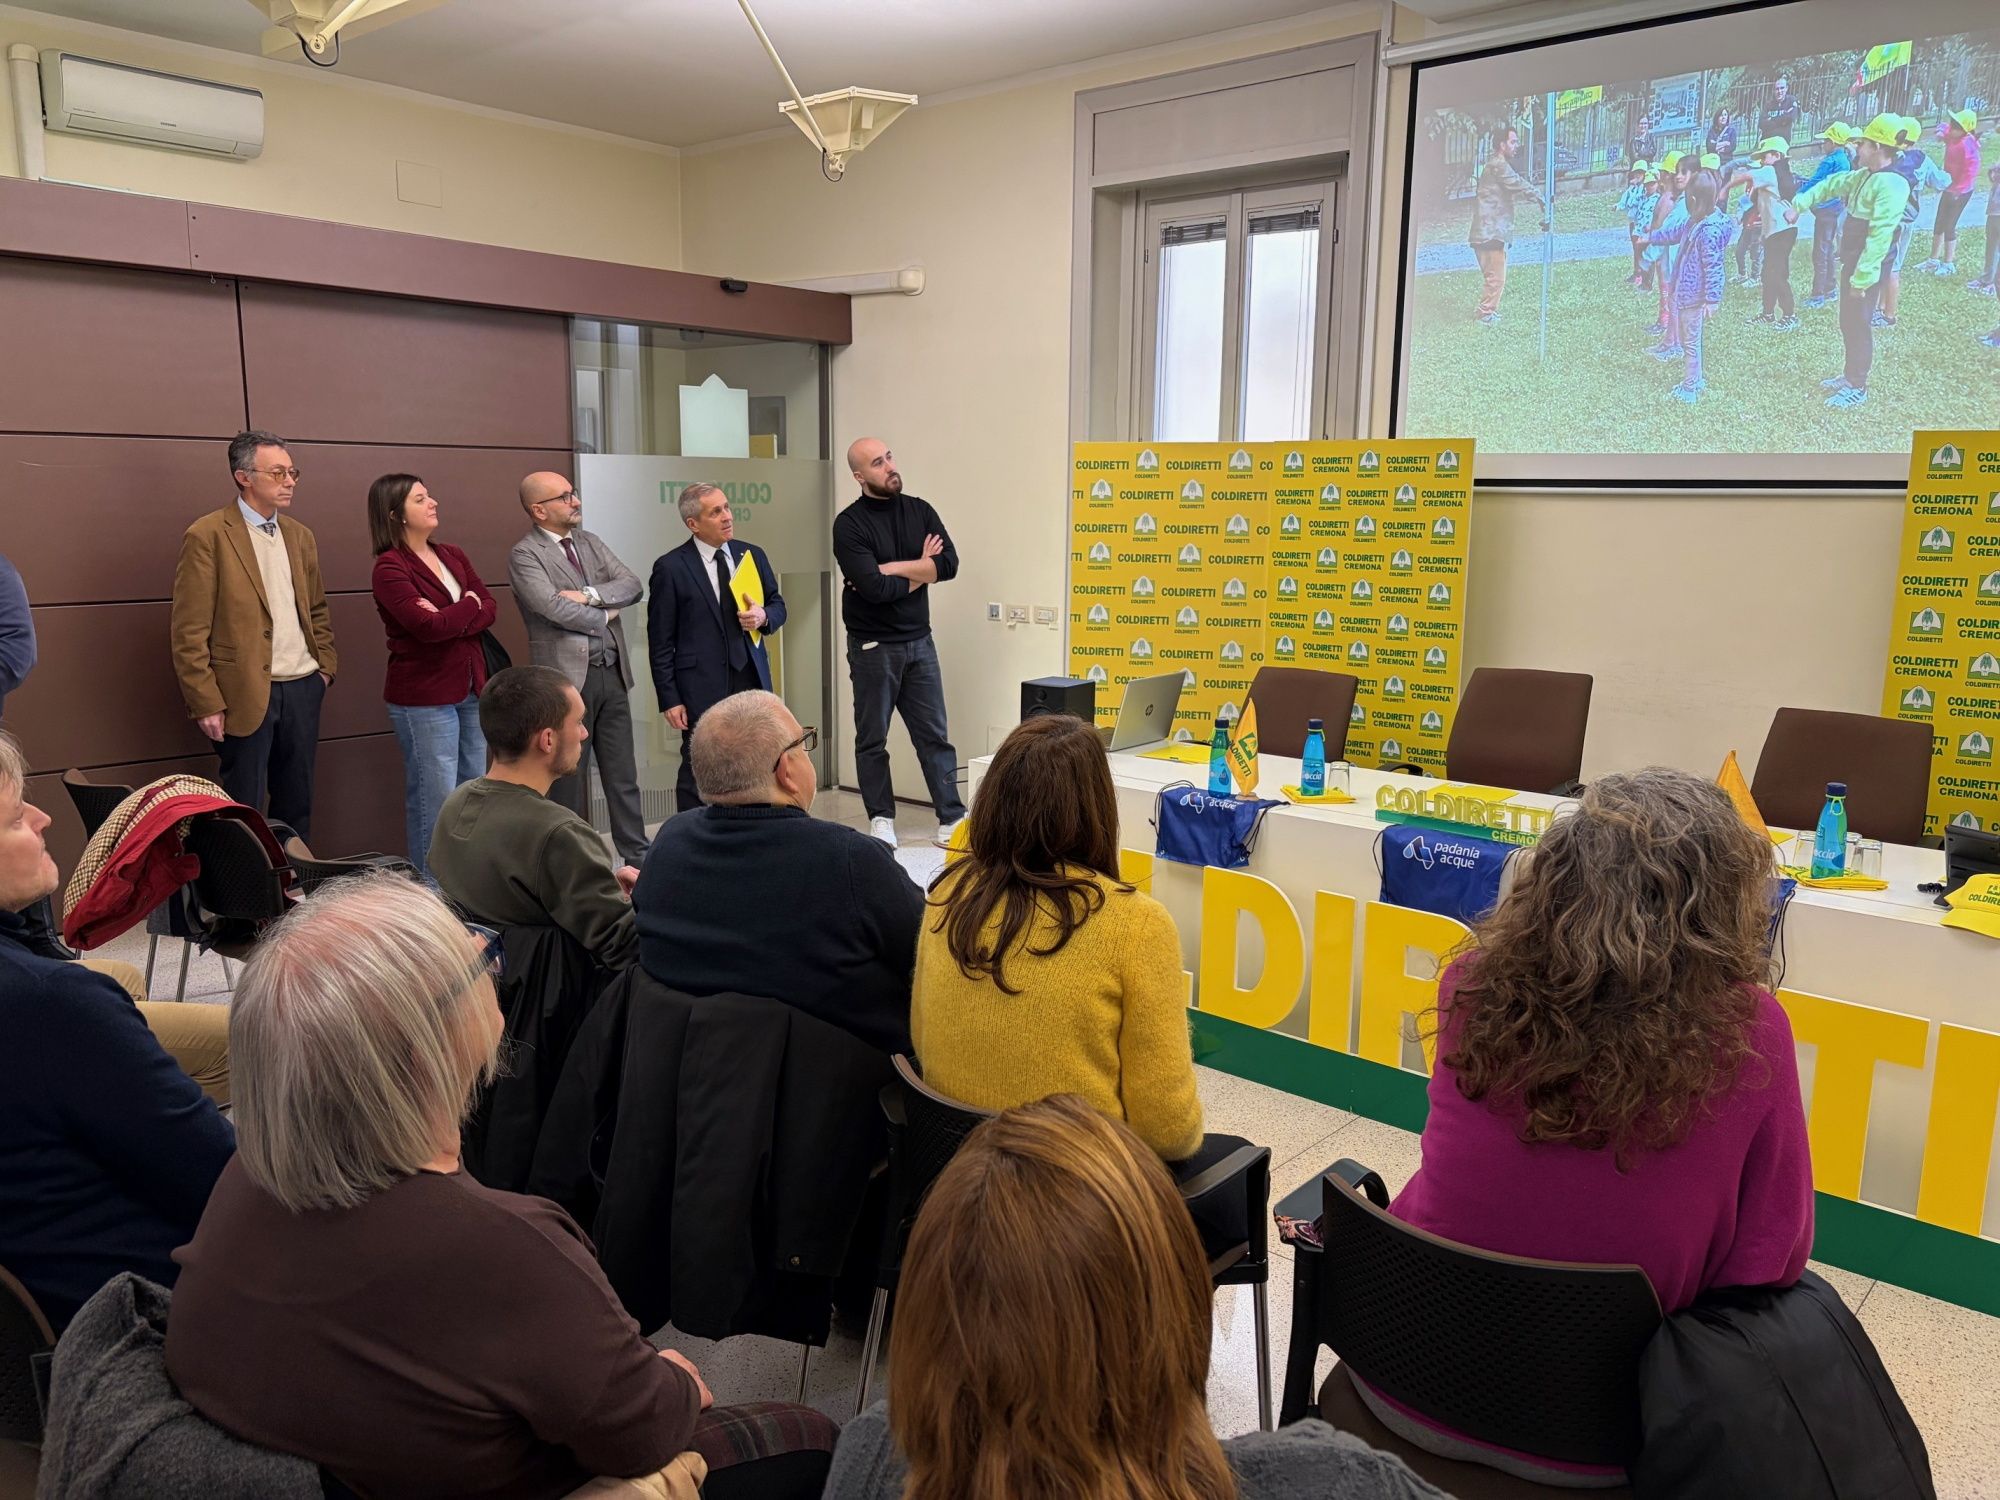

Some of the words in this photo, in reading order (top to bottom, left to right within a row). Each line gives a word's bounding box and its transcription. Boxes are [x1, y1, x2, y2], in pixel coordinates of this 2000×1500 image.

[1076, 461, 1129, 470] COLDIRETTI
[1166, 461, 1221, 470] COLDIRETTI
[1120, 491, 1173, 500] COLDIRETTI
[1211, 492, 1267, 501] COLDIRETTI
[1346, 490, 1388, 498] COLDIRETTI
[1912, 495, 1978, 504] COLDIRETTI
[1914, 507, 1973, 515] CREMONA
[1075, 524, 1127, 533] COLDIRETTI
[1164, 525, 1218, 534] COLDIRETTI
[1383, 522, 1425, 530] COLDIRETTI
[1118, 554, 1171, 563] COLDIRETTI
[1209, 555, 1264, 565] COLDIRETTI
[1343, 554, 1384, 562] COLDIRETTI
[1418, 556, 1462, 565] COLDIRETTI
[1419, 566, 1458, 574] CREMONA
[1903, 576, 1968, 587] COLDIRETTI
[1073, 586, 1125, 595] COLDIRETTI
[1306, 583, 1345, 591] COLDIRETTI
[1379, 587, 1421, 595] COLDIRETTI
[1162, 588, 1215, 597] COLDIRETTI
[1904, 588, 1962, 597] CREMONA
[1116, 615, 1169, 625] COLDIRETTI
[1269, 612, 1308, 621] COLDIRETTI
[1340, 617, 1380, 625] COLDIRETTI
[1206, 618, 1260, 627] COLDIRETTI
[1271, 621, 1305, 629] CREMONA
[1414, 622, 1457, 631] COLDIRETTI
[1957, 618, 2000, 628] COLDIR
[1341, 626, 1378, 634] CREMONA
[1959, 630, 2000, 639] CREMO
[1415, 631, 1454, 639] CREMONA
[1072, 647, 1123, 656] COLDIRETTI
[1303, 643, 1342, 652] COLDIRETTI
[1160, 650, 1213, 659] COLDIRETTI
[1304, 652, 1339, 660] CREMONA
[1375, 649, 1417, 658] COLDIRETTI
[1377, 658, 1415, 666] CREMONA
[1893, 656, 1958, 668] COLDIRETTI
[1895, 668, 1952, 678] CREMONA
[1203, 680, 1253, 689] COLDIRET
[1358, 679, 1377, 687] RETTI
[1410, 684, 1453, 694] COLDIRETTI
[1412, 693, 1450, 702] CREMONA
[1174, 711, 1210, 720] DIRETTI
[1372, 712, 1414, 722] COLDIRETTI
[1950, 709, 2000, 719] CREMON
[1374, 721, 1411, 730] CREMONA
[1345, 749, 1371, 757] EMONA
[1406, 747, 1447, 757] COLDIRETT
[1408, 756, 1446, 766] CREMONA
[1955, 759, 1991, 767] COLDIRETTI
[1938, 776, 2000, 790] COLDIRETT
[1940, 788, 1998, 801] CREMONA
[1209, 799, 1236, 810] acque
[1491, 831, 1540, 846] CREMO
[1434, 842, 1479, 858] padania
[1440, 855, 1474, 869] acque
[1968, 894, 2000, 906] COLDIRE
